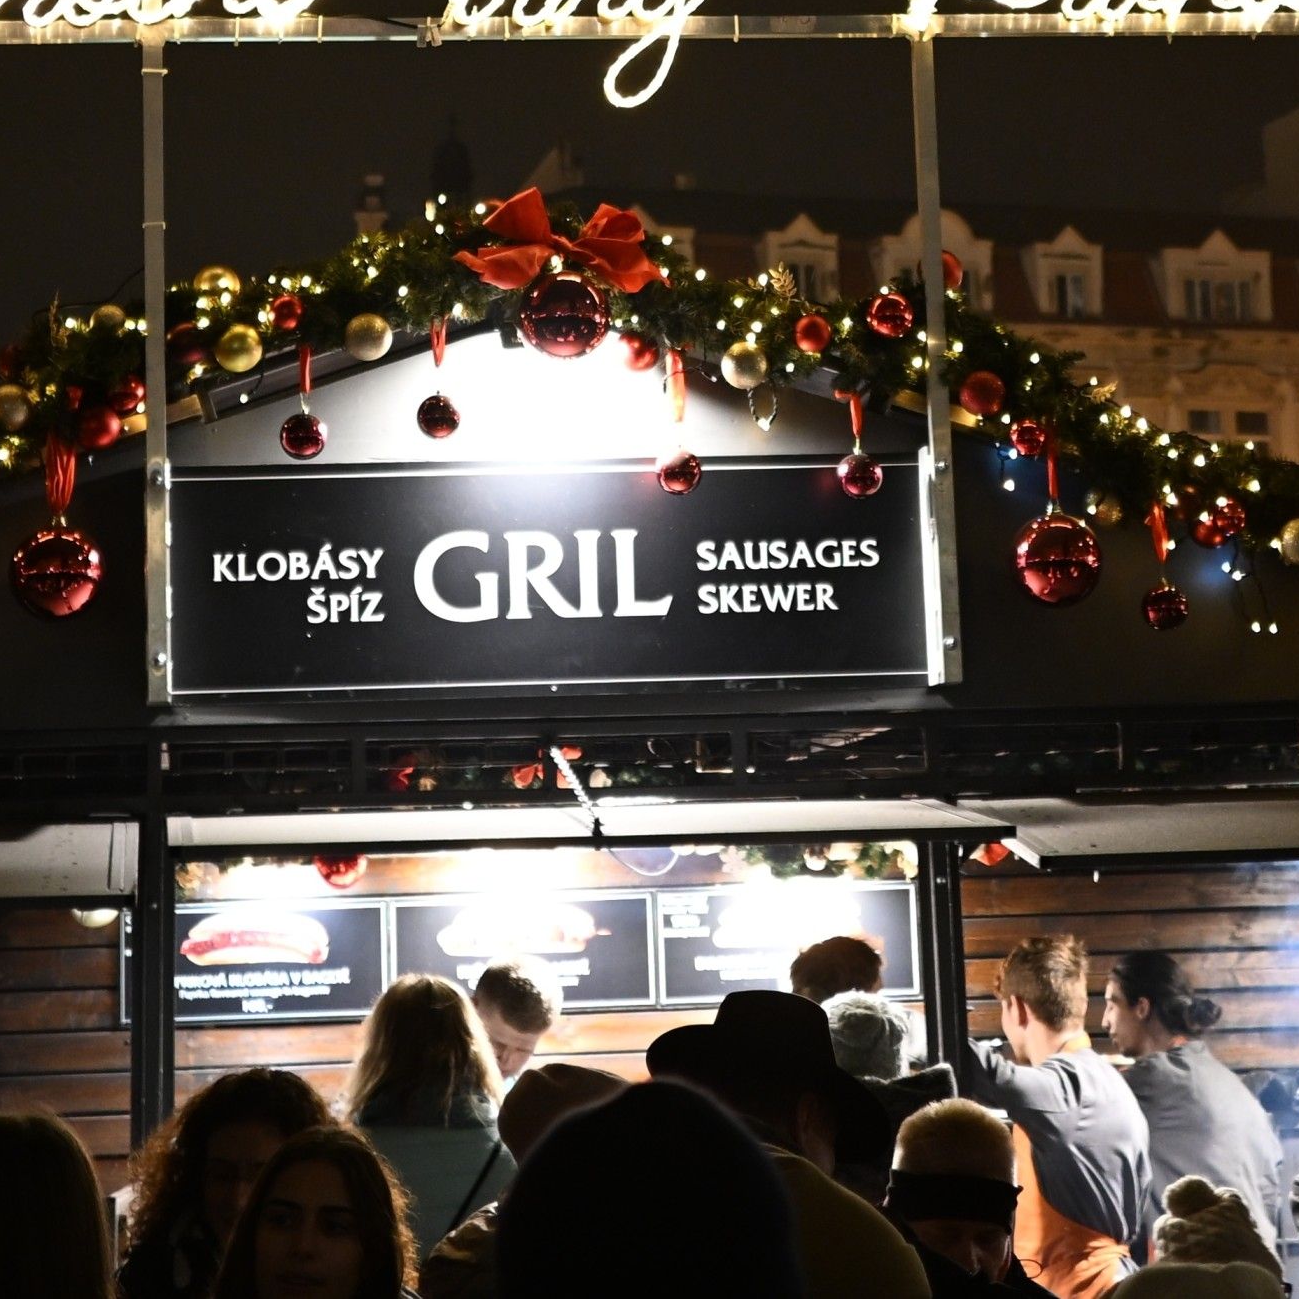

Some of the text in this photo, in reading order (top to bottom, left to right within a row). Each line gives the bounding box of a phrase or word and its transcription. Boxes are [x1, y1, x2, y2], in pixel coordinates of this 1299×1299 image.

[212, 543, 385, 582] KLOBÁSY
[696, 539, 880, 572] SAUSAGES
[413, 529, 673, 622] GRIL
[306, 585, 385, 624] ŠPÍZ
[696, 581, 839, 615] SKEWER
